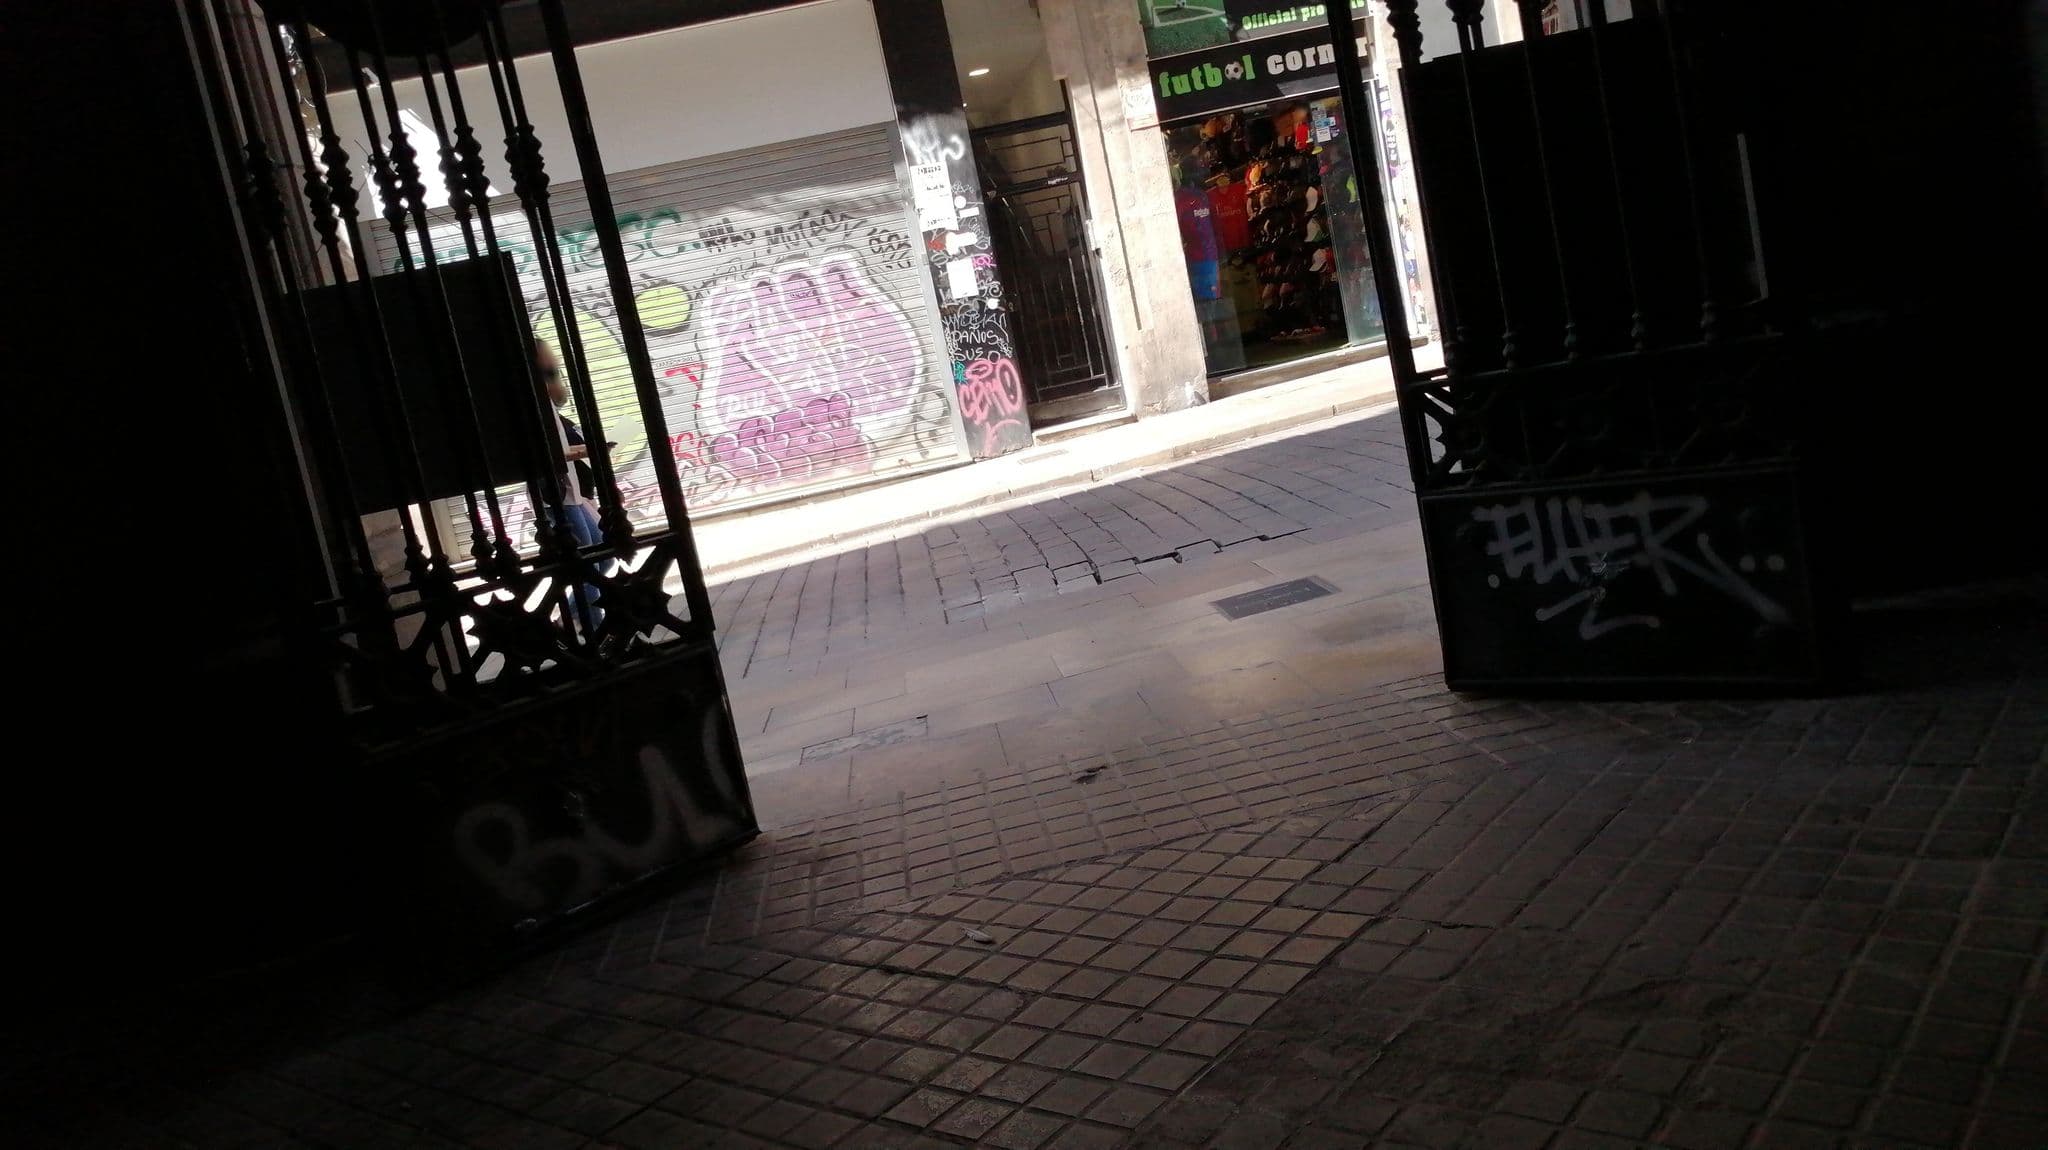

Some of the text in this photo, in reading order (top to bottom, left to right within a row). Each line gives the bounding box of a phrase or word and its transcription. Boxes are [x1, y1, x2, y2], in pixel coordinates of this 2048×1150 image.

[1242, 7, 1297, 30] Official
[1159, 37, 1368, 98] futbol cornr
